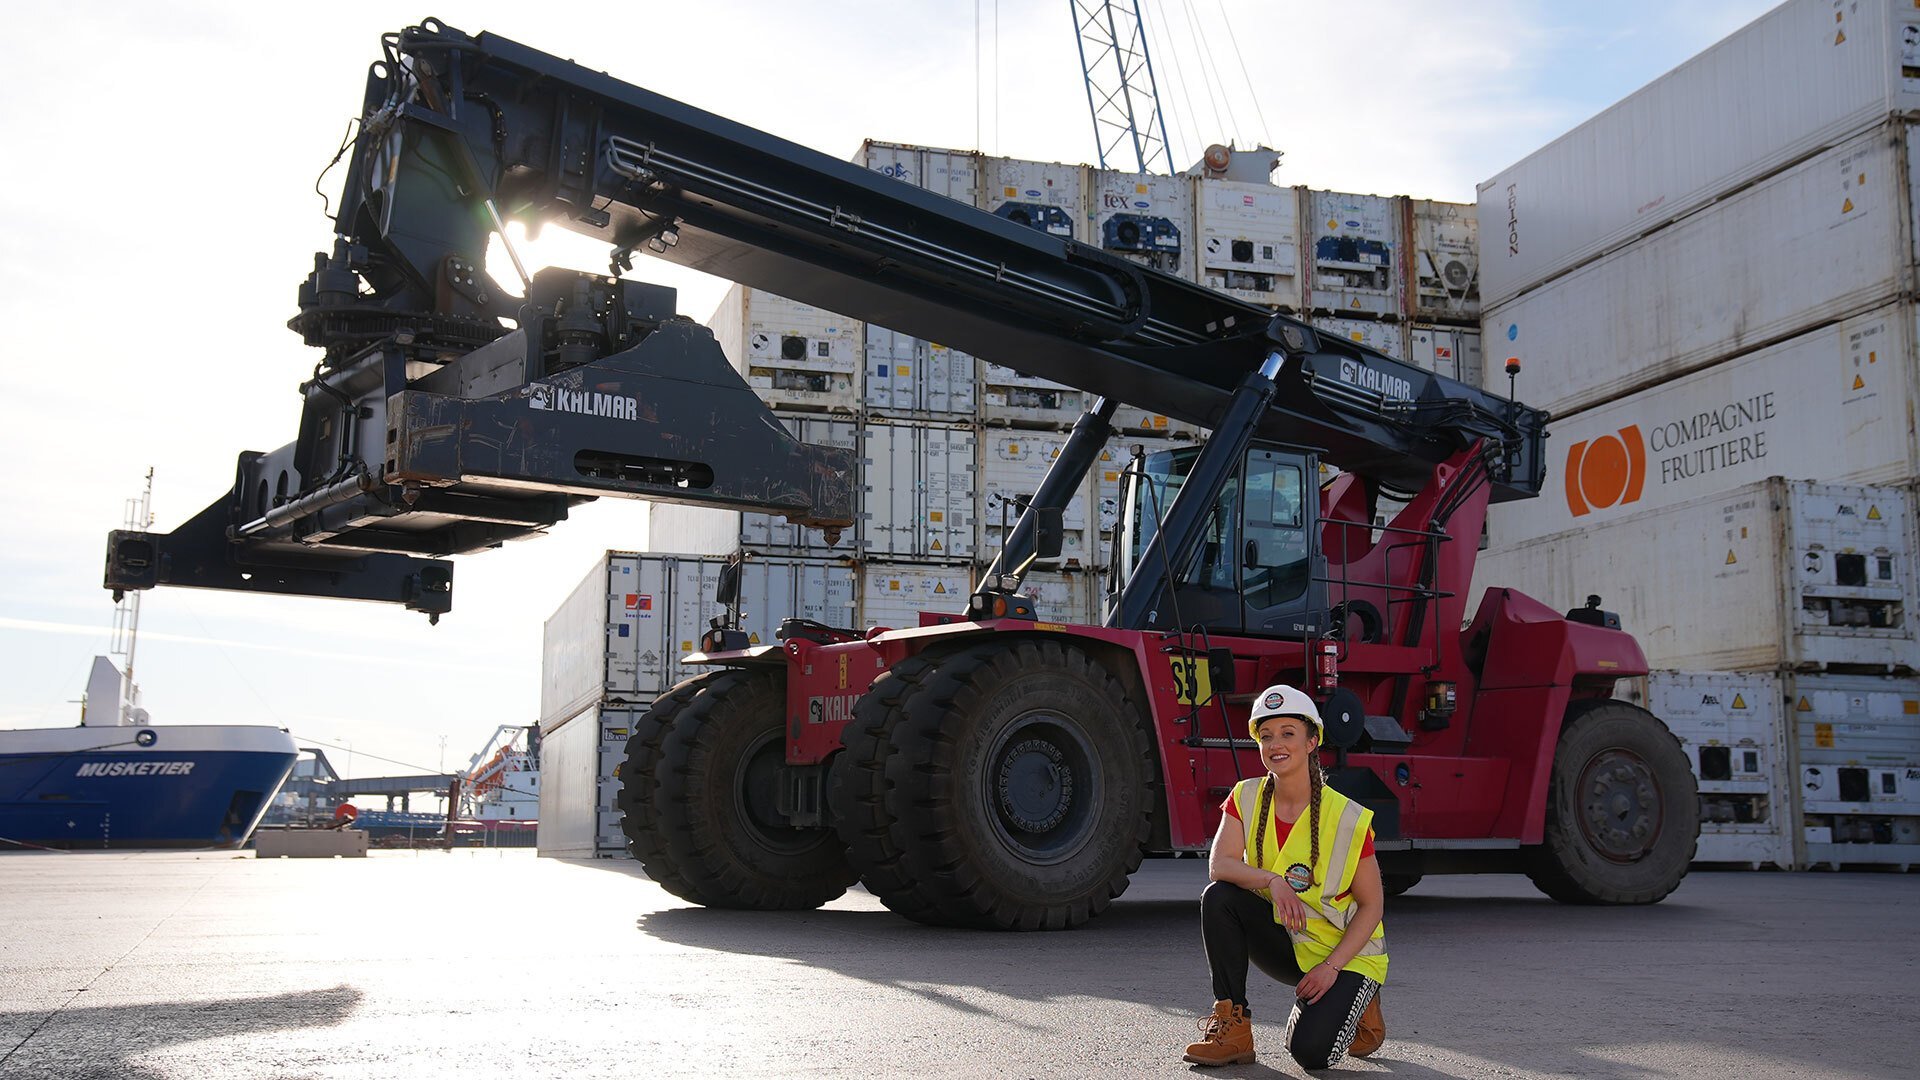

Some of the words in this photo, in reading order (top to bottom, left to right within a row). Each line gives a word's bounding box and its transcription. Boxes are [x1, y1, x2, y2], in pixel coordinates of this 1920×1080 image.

[1104, 193, 1129, 209] tex
[1507, 183, 1519, 258] TRITON
[1358, 365, 1411, 400] KALMAR
[557, 387, 637, 421] KALMAR
[1650, 391, 1776, 452] COMPAGNIE
[1661, 431, 1768, 485] FRUITIERE
[1172, 661, 1198, 700] S5
[76, 761, 195, 777] MUSKETIER
